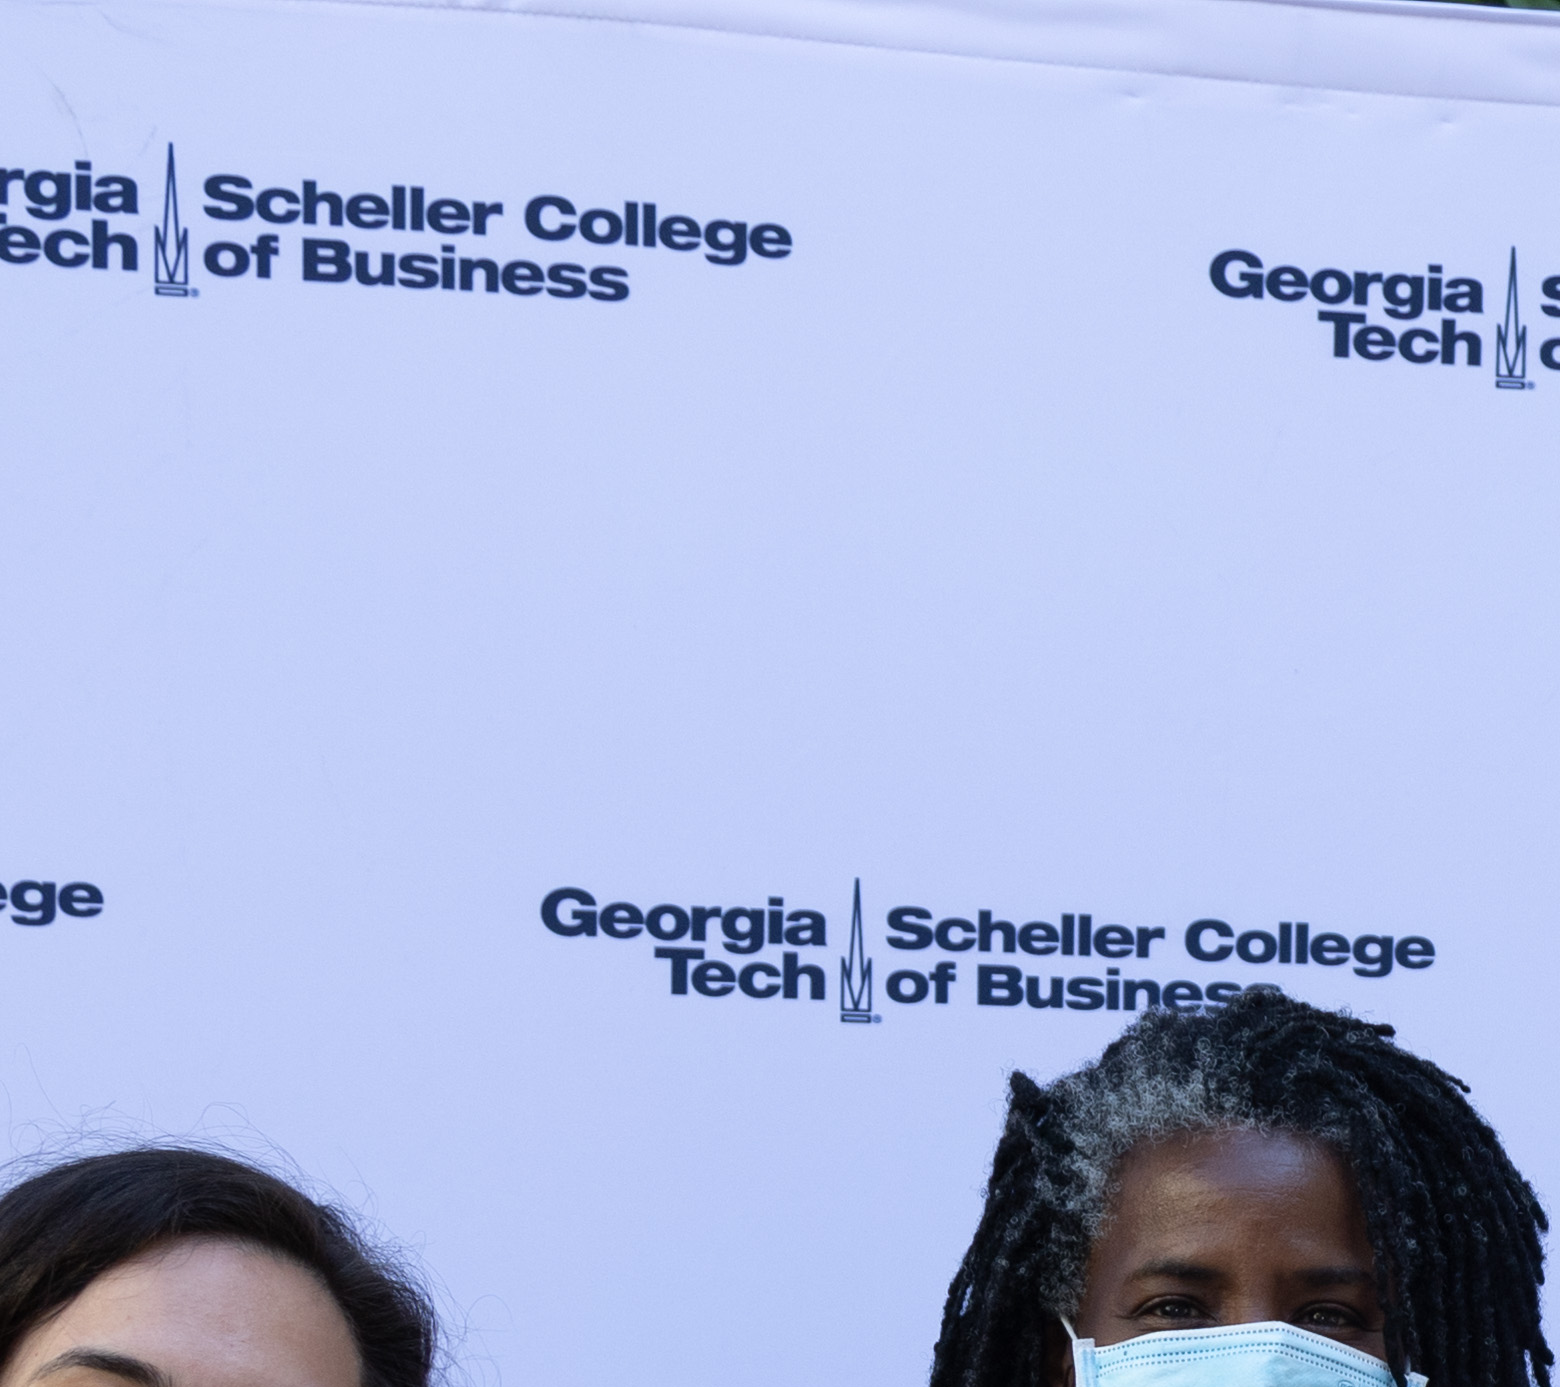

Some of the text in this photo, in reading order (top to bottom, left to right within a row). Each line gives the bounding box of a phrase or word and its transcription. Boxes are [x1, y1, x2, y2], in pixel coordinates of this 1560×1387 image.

[204, 175, 792, 265] Scheller College
[204, 235, 629, 301] of Business
[1210, 251, 1482, 320] Georgia
[1318, 311, 1481, 366] Tech
[541, 888, 826, 954] Georgia
[887, 907, 1435, 977] Scheller College
[655, 947, 825, 1000] Tech
[886, 962, 1282, 1014] of Busines
